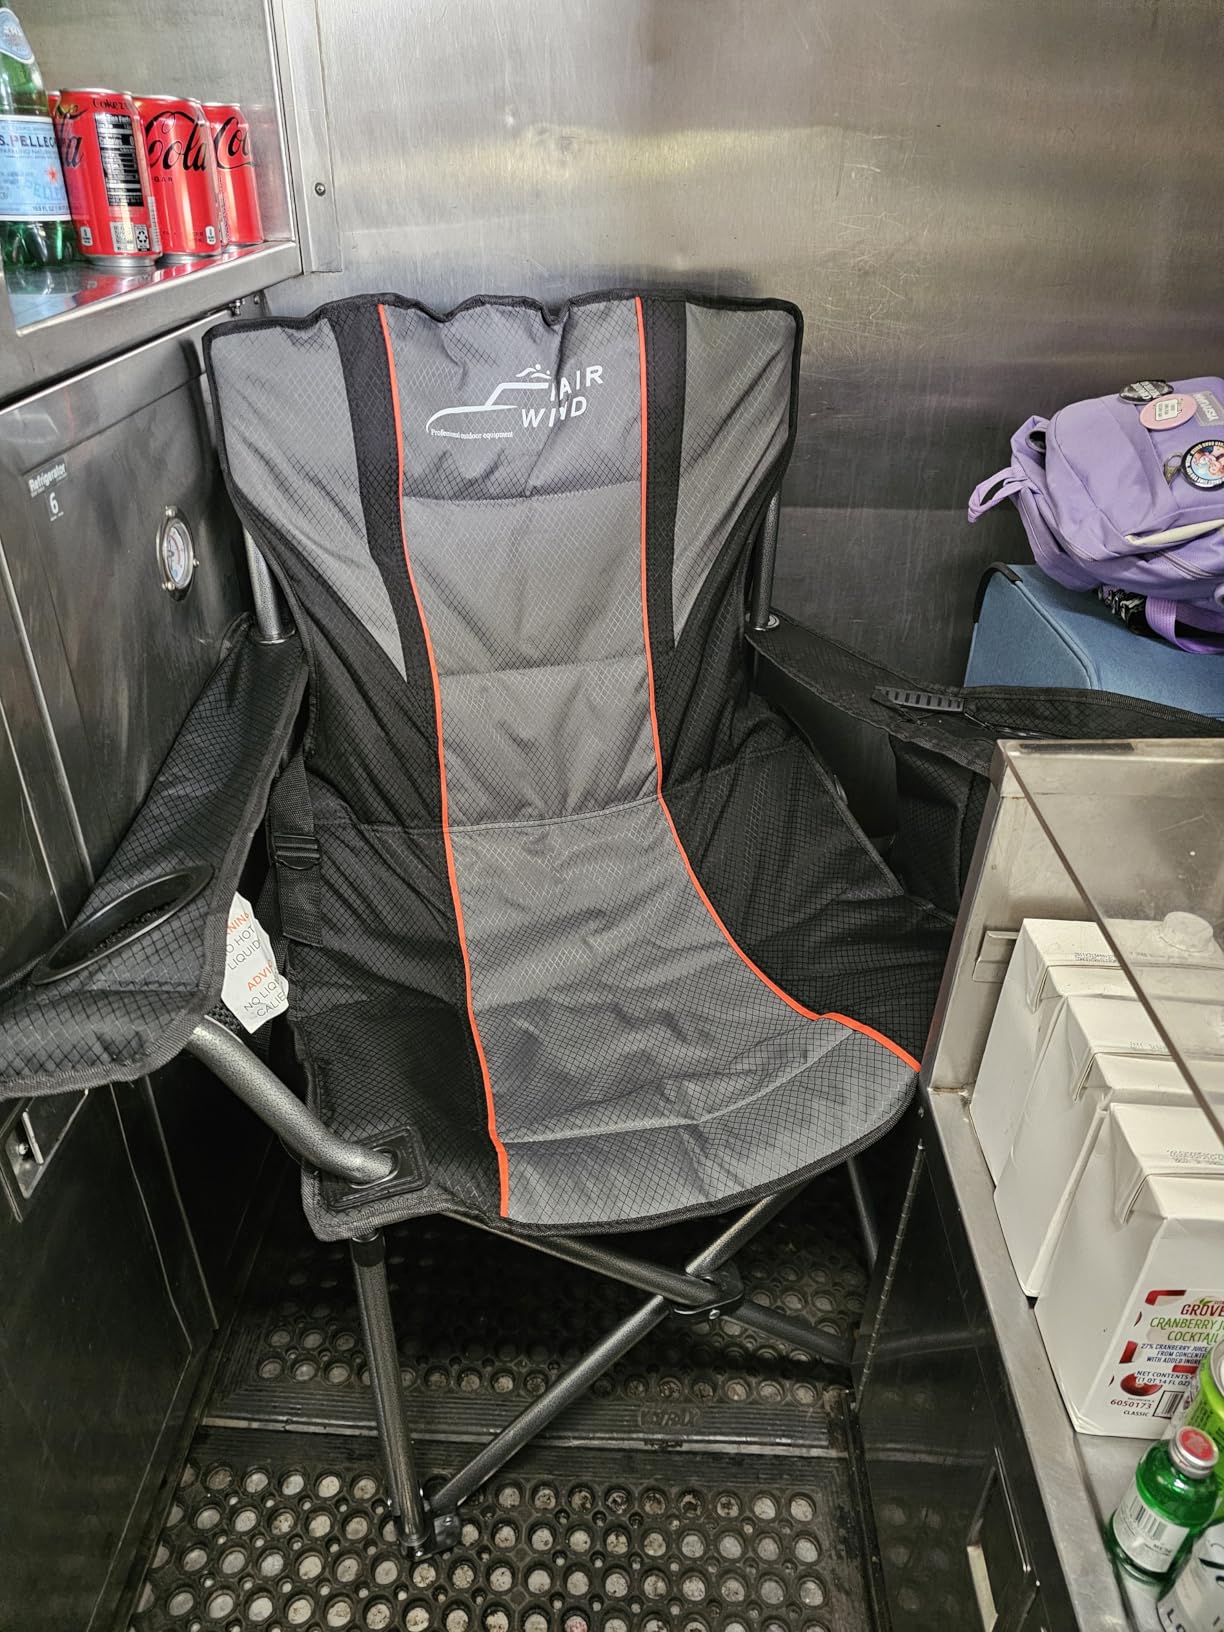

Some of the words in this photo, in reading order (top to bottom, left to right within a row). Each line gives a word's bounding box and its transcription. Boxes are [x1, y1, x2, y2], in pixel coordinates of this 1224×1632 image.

[521, 396, 587, 428] WIND
[482, 431, 513, 440] equipment
[29, 463, 66, 492] Refrigerator
[49, 492, 59, 514] 6
[233, 924, 256, 946] HOT
[243, 996, 261, 1012] NO
[1150, 1317, 1218, 1330] CRANBERRY
[1167, 1331, 1219, 1345] COCKTAIL
[1154, 1344, 1191, 1352] CRANBERRY
[1156, 1350, 1174, 1358] FROM
[1151, 1371, 1189, 1380] CONTENTS
[1110, 1399, 1152, 1410] 6050173
[1123, 1409, 1150, 1417] CLASSIC
